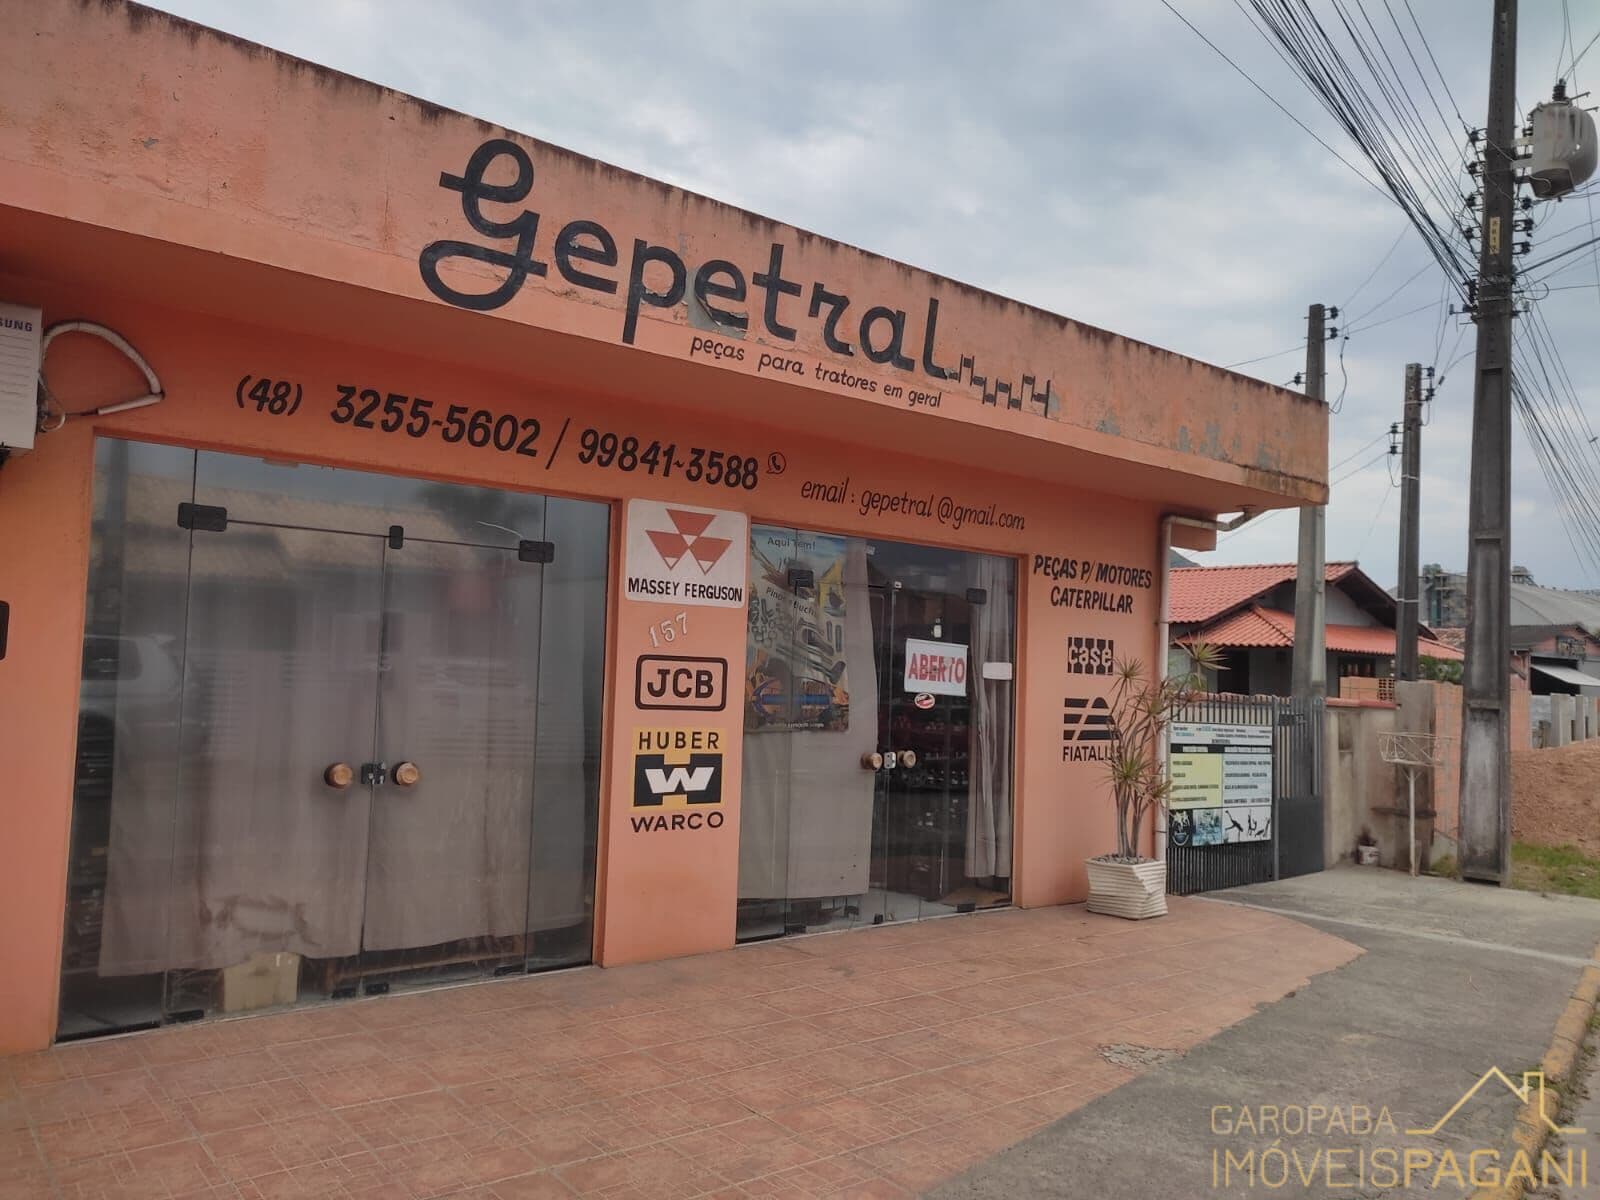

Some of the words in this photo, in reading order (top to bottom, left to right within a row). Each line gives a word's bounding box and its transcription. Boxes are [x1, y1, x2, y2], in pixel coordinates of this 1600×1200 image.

[690, 335, 745, 361] peças
[757, 352, 805, 375] para
[814, 363, 878, 392] tratores
[883, 383, 903, 399] em
[908, 392, 942, 408] geral
[236, 374, 303, 416] (48)
[330, 384, 541, 457] 3255-5602
[578, 428, 759, 490] 99841-3588
[1033, 554, 1077, 580] PEÇAS
[1095, 563, 1152, 589] MOTORES
[628, 577, 680, 596] MASSEY
[684, 582, 743, 602] FERGUSON
[1050, 586, 1133, 614] CATERPILLAR
[649, 612, 688, 648] 157
[908, 653, 966, 684] ABERTO
[1068, 645, 1113, 668] case
[647, 668, 714, 699] JCB
[638, 731, 720, 750] HUBER
[630, 811, 724, 833] WARCO
